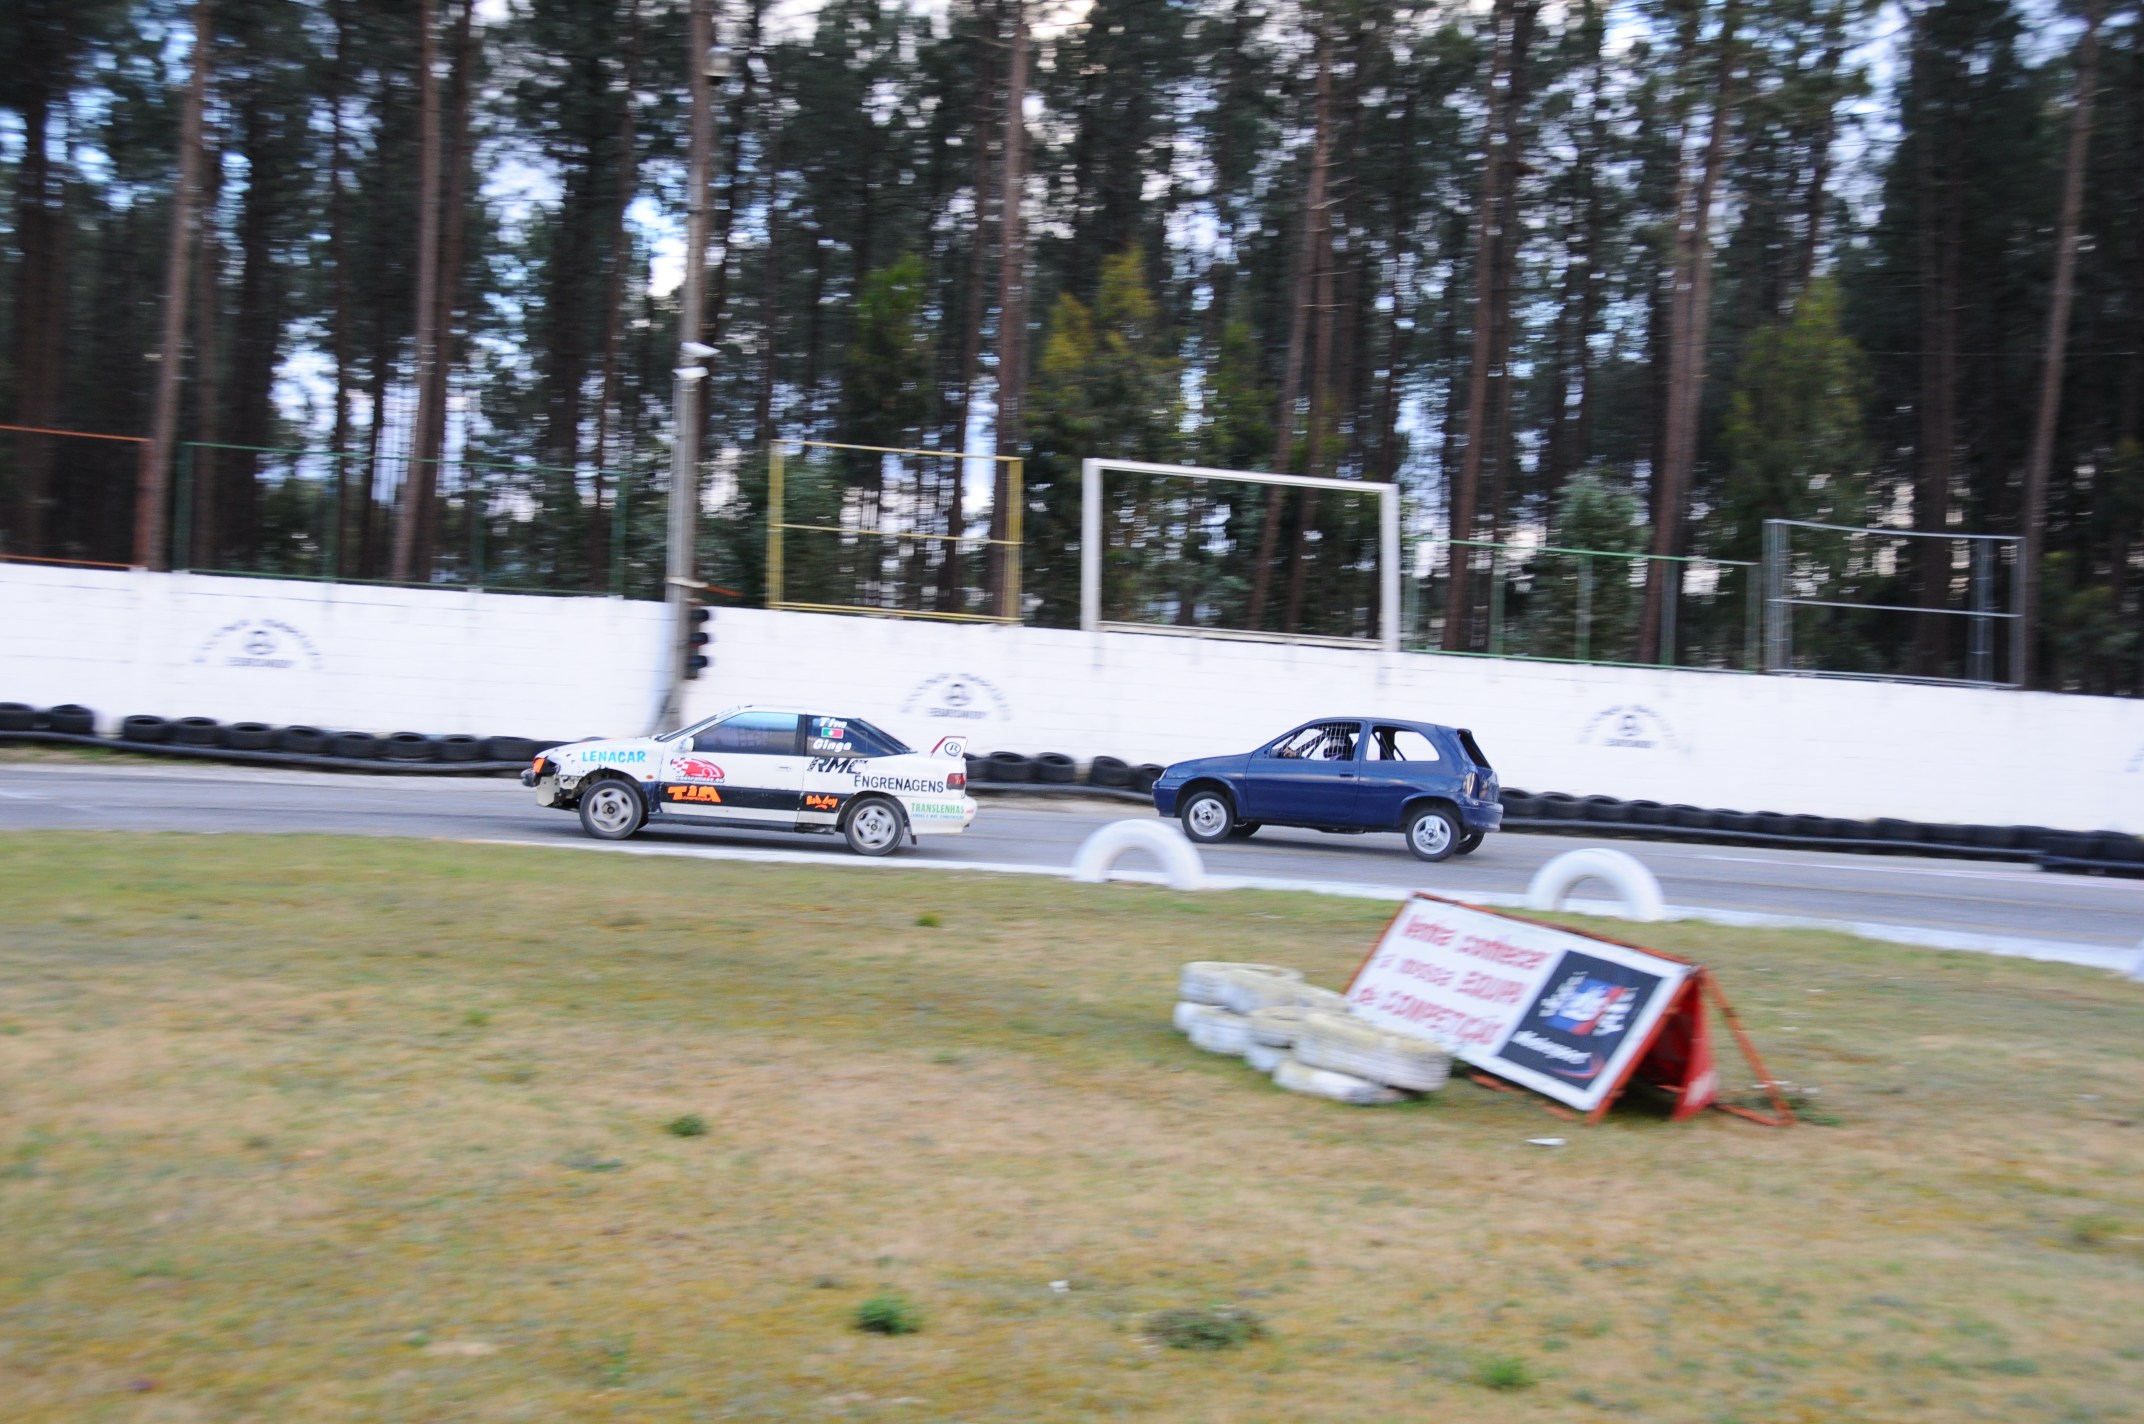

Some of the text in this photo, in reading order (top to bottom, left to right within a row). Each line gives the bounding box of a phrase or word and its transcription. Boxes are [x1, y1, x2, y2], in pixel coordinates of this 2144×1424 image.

[819, 717, 847, 728] Tim
[582, 751, 646, 763] LENACAR
[807, 757, 868, 774] RMC
[854, 774, 944, 793] ENGRENAGENS
[911, 803, 965, 814] TRANSLENHAS
